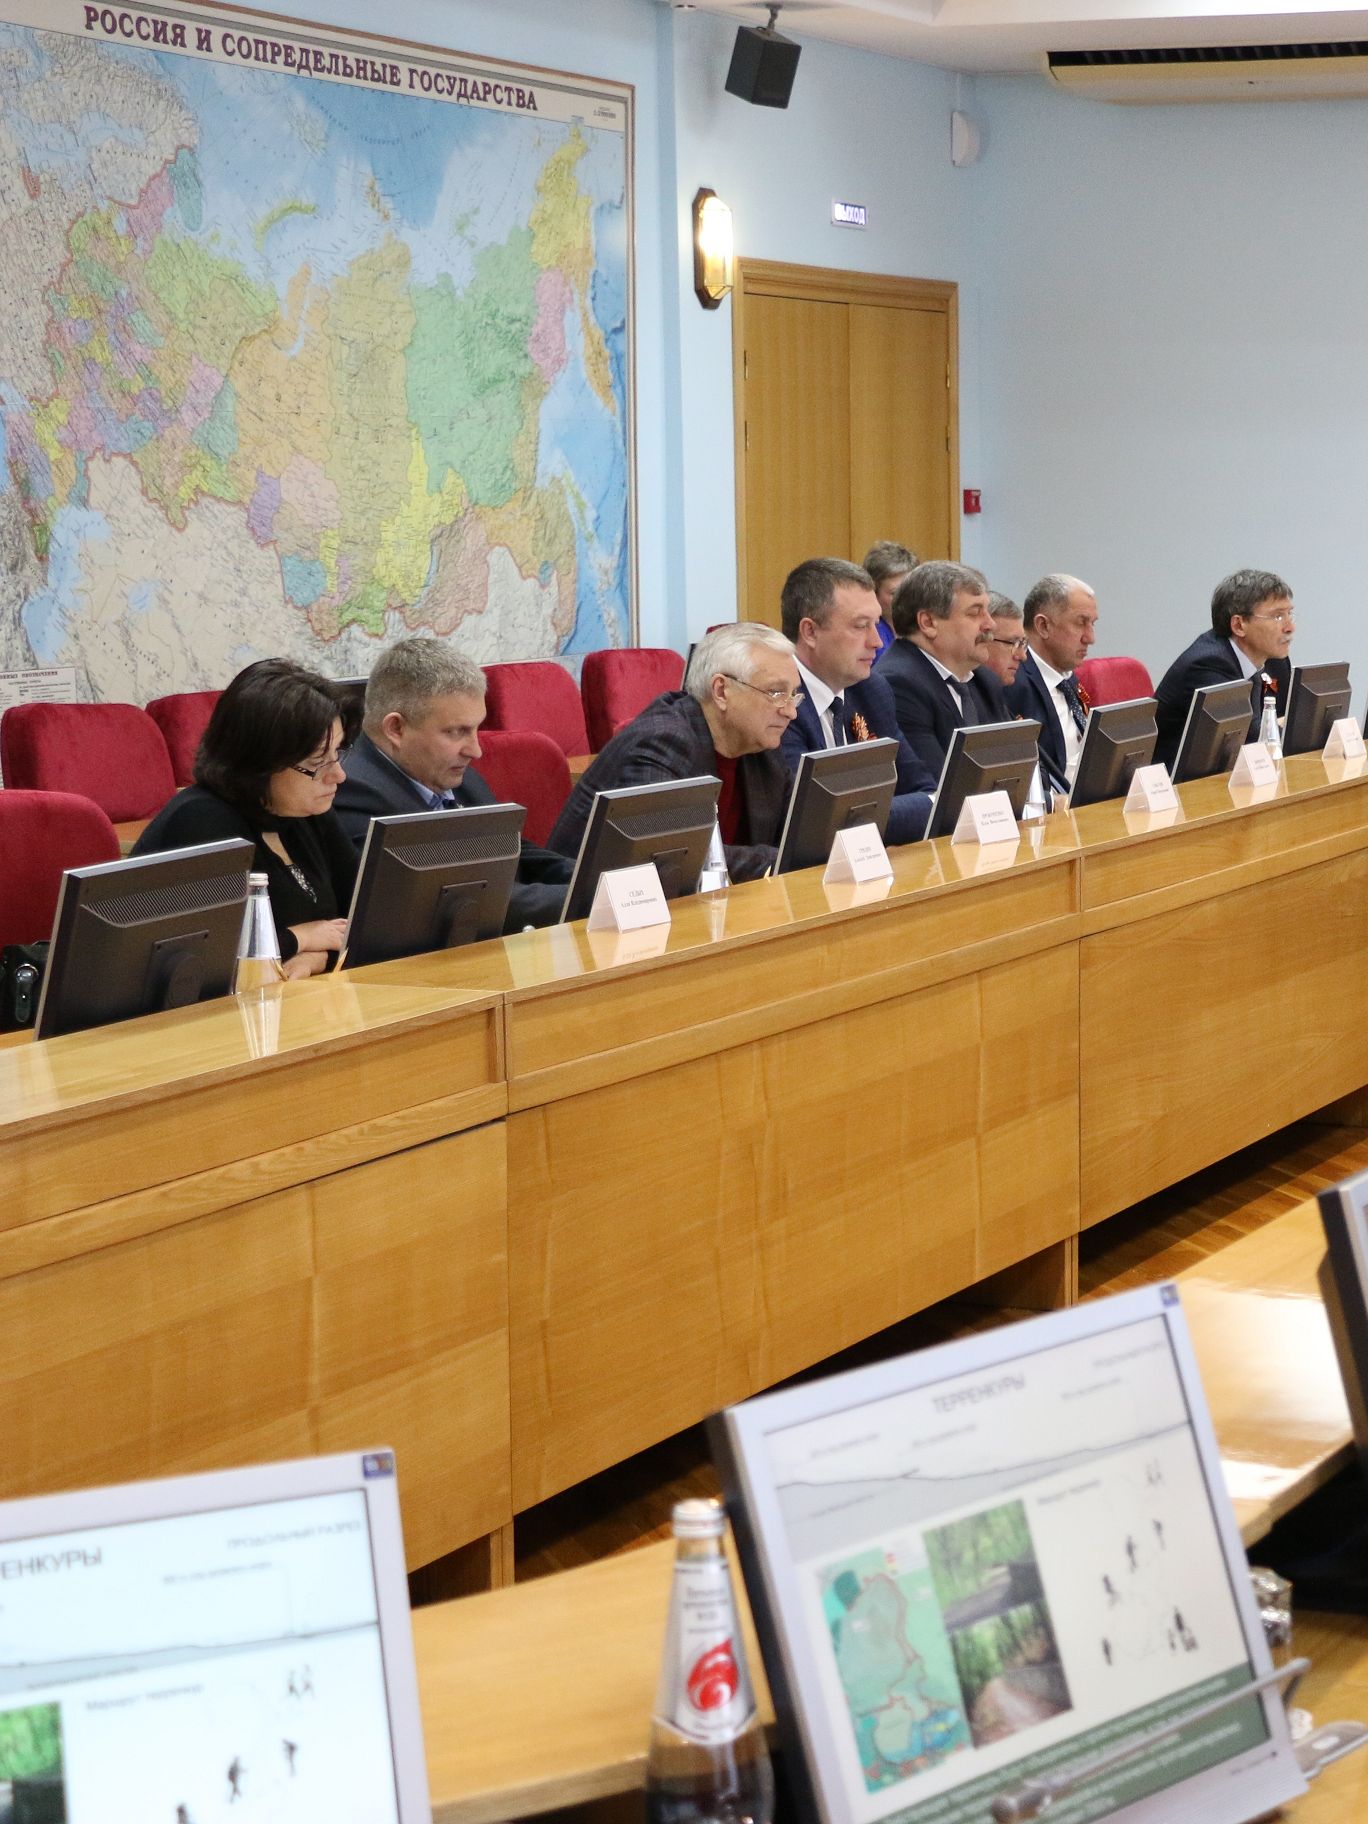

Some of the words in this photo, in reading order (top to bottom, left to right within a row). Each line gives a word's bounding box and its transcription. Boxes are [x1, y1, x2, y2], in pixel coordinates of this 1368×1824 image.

[84, 5, 187, 49] РОССИЯ
[195, 27, 213, 53] И
[221, 32, 401, 86] СОПРЕДЕЛЬНЫЕ
[408, 68, 538, 111] ГОСУДАРСТВА
[0, 1546, 103, 1581] ЕНКУРЫ
